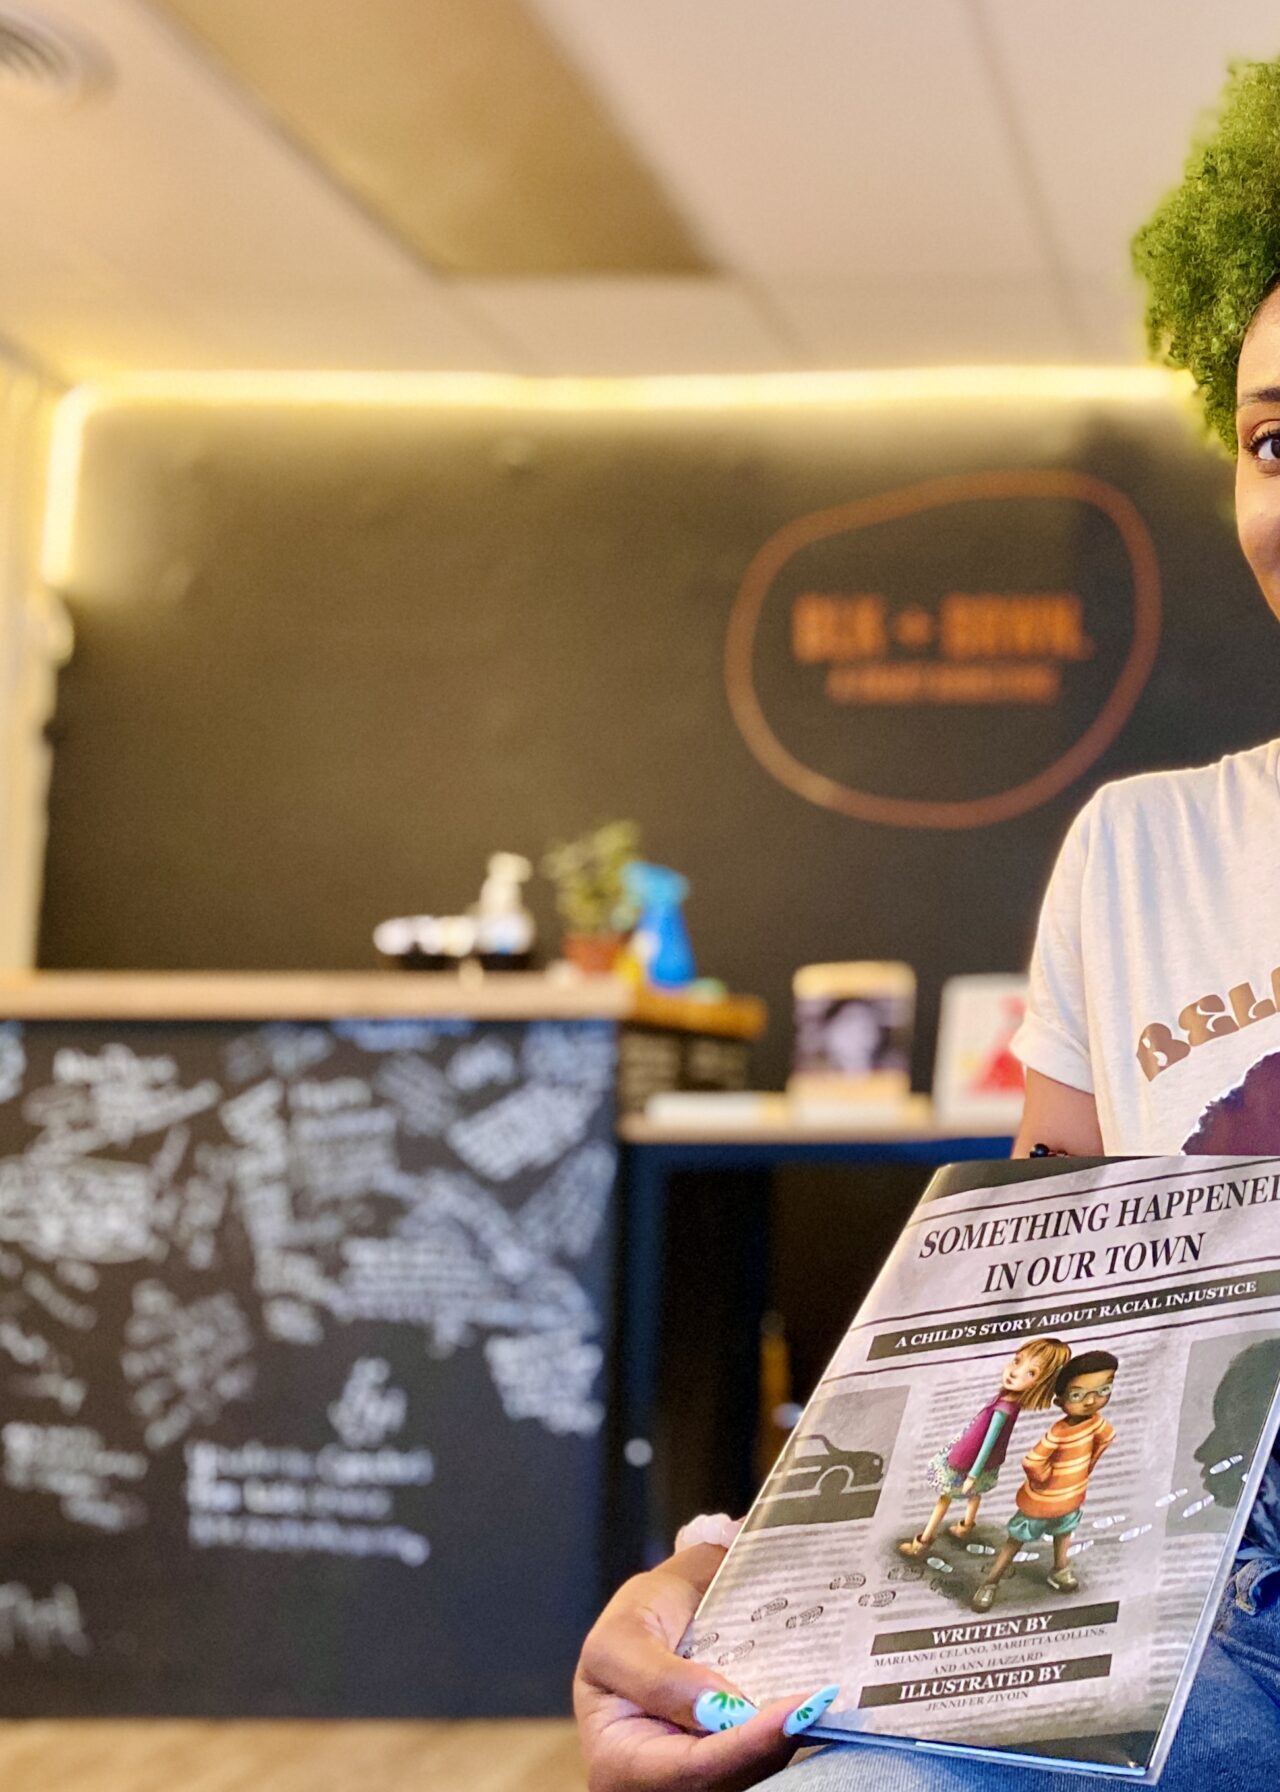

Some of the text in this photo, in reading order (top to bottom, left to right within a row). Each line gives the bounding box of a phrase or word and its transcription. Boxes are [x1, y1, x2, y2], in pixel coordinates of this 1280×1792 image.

[918, 1202, 1110, 1259] SOMETHING
[980, 1232, 1206, 1294] IN OUR TOWN
[894, 1281, 1258, 1349] A CHILD'S STORY ABOUT RACIAL INJUSTICE
[932, 1615, 1053, 1645] WRITTEN BY
[873, 1651, 939, 1668] MARIANNE
[991, 1636, 1052, 1652] MARIETTA
[932, 1652, 1045, 1676] AND ANN HAZZARD
[899, 1664, 1067, 1700] ILLUSTRATED BY
[925, 1690, 1031, 1712] JENNIFER ZIVOIN
